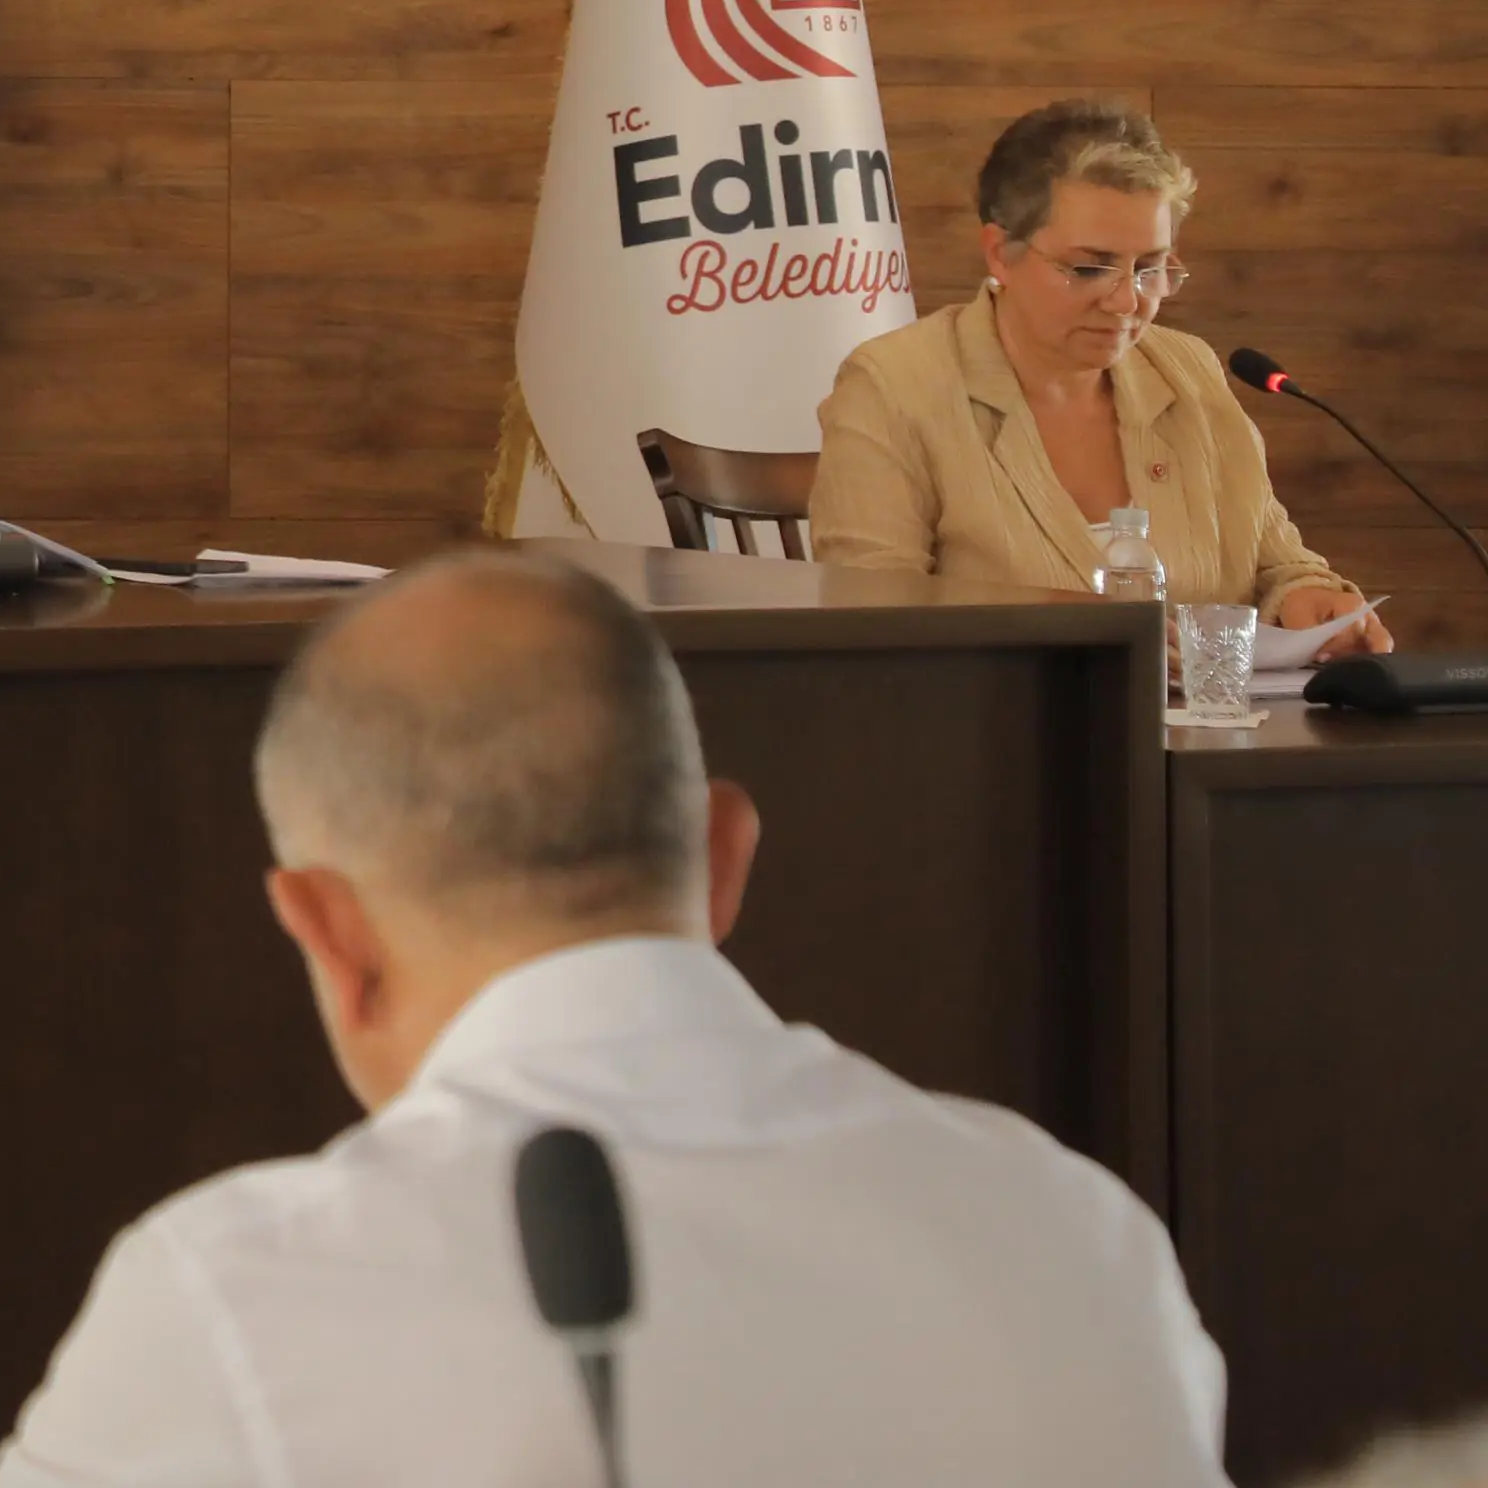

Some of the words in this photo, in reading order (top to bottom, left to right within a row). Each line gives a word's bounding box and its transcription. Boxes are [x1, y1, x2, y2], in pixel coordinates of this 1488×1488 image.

[805, 15, 858, 34] 1867
[606, 107, 650, 134] T.C.
[1445, 667, 1488, 680] VISSO
